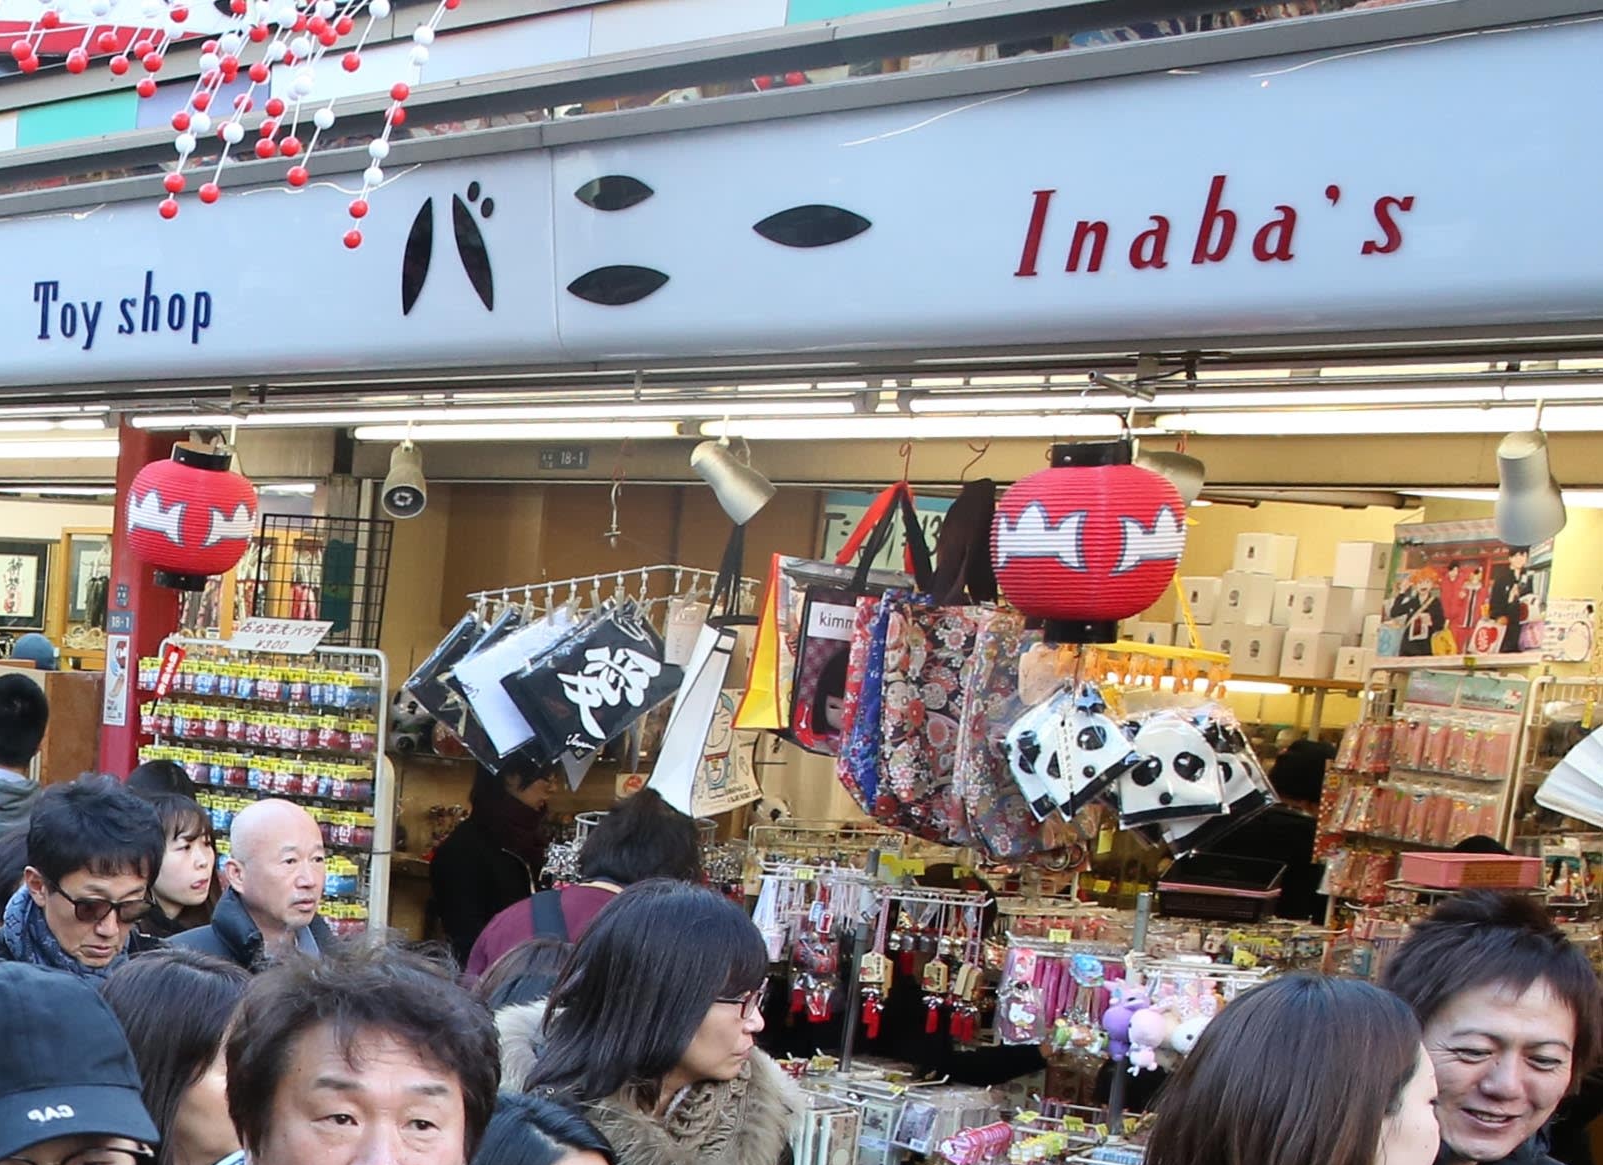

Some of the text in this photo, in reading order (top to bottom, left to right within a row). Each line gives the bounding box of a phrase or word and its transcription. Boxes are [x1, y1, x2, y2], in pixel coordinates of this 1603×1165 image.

[1014, 175, 1415, 277] Inaba's
[33, 270, 212, 350] Toy shop
[255, 640, 290, 650] ¥300
